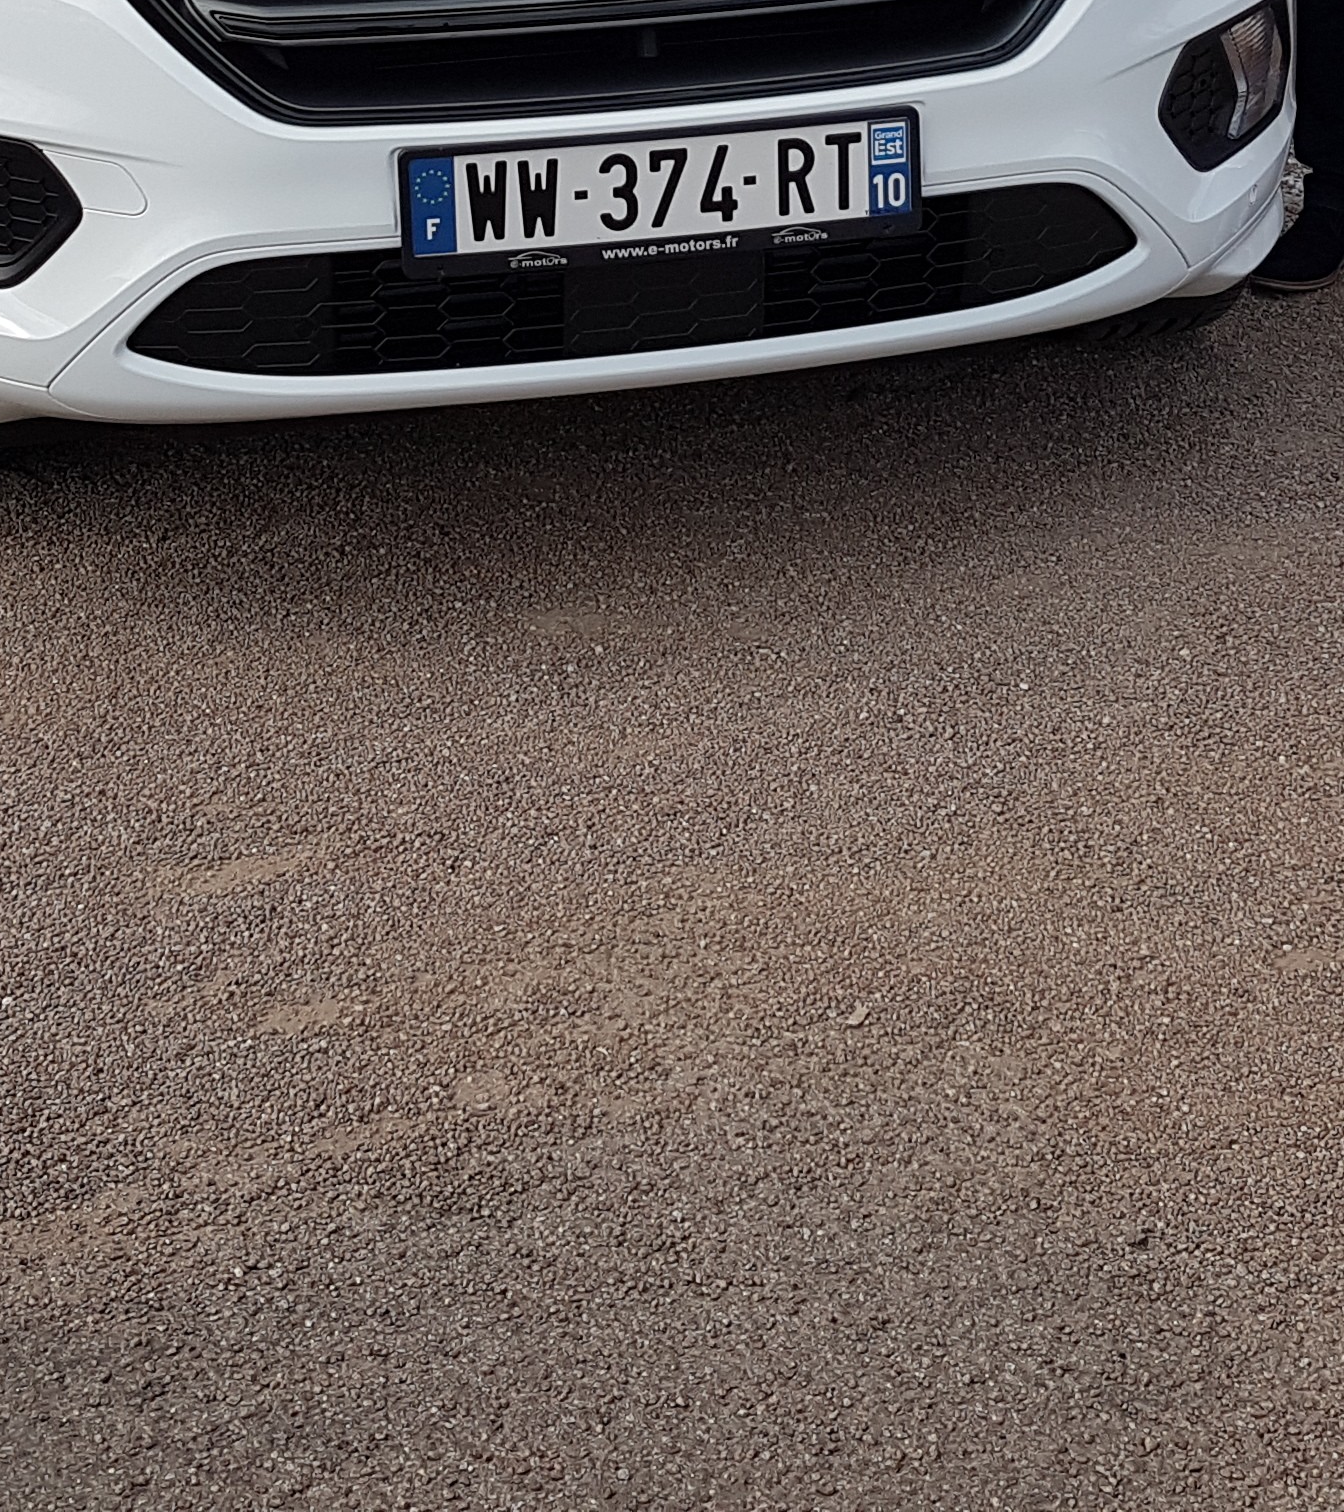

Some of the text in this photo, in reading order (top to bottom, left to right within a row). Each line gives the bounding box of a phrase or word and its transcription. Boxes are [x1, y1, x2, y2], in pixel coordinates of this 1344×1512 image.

[874, 129, 903, 140] Grand
[874, 139, 903, 156] Est
[465, 131, 862, 242] WW-374-RT
[872, 172, 906, 208] 10
[426, 218, 441, 240] F
[601, 234, 739, 259] www.e-motors.fr
